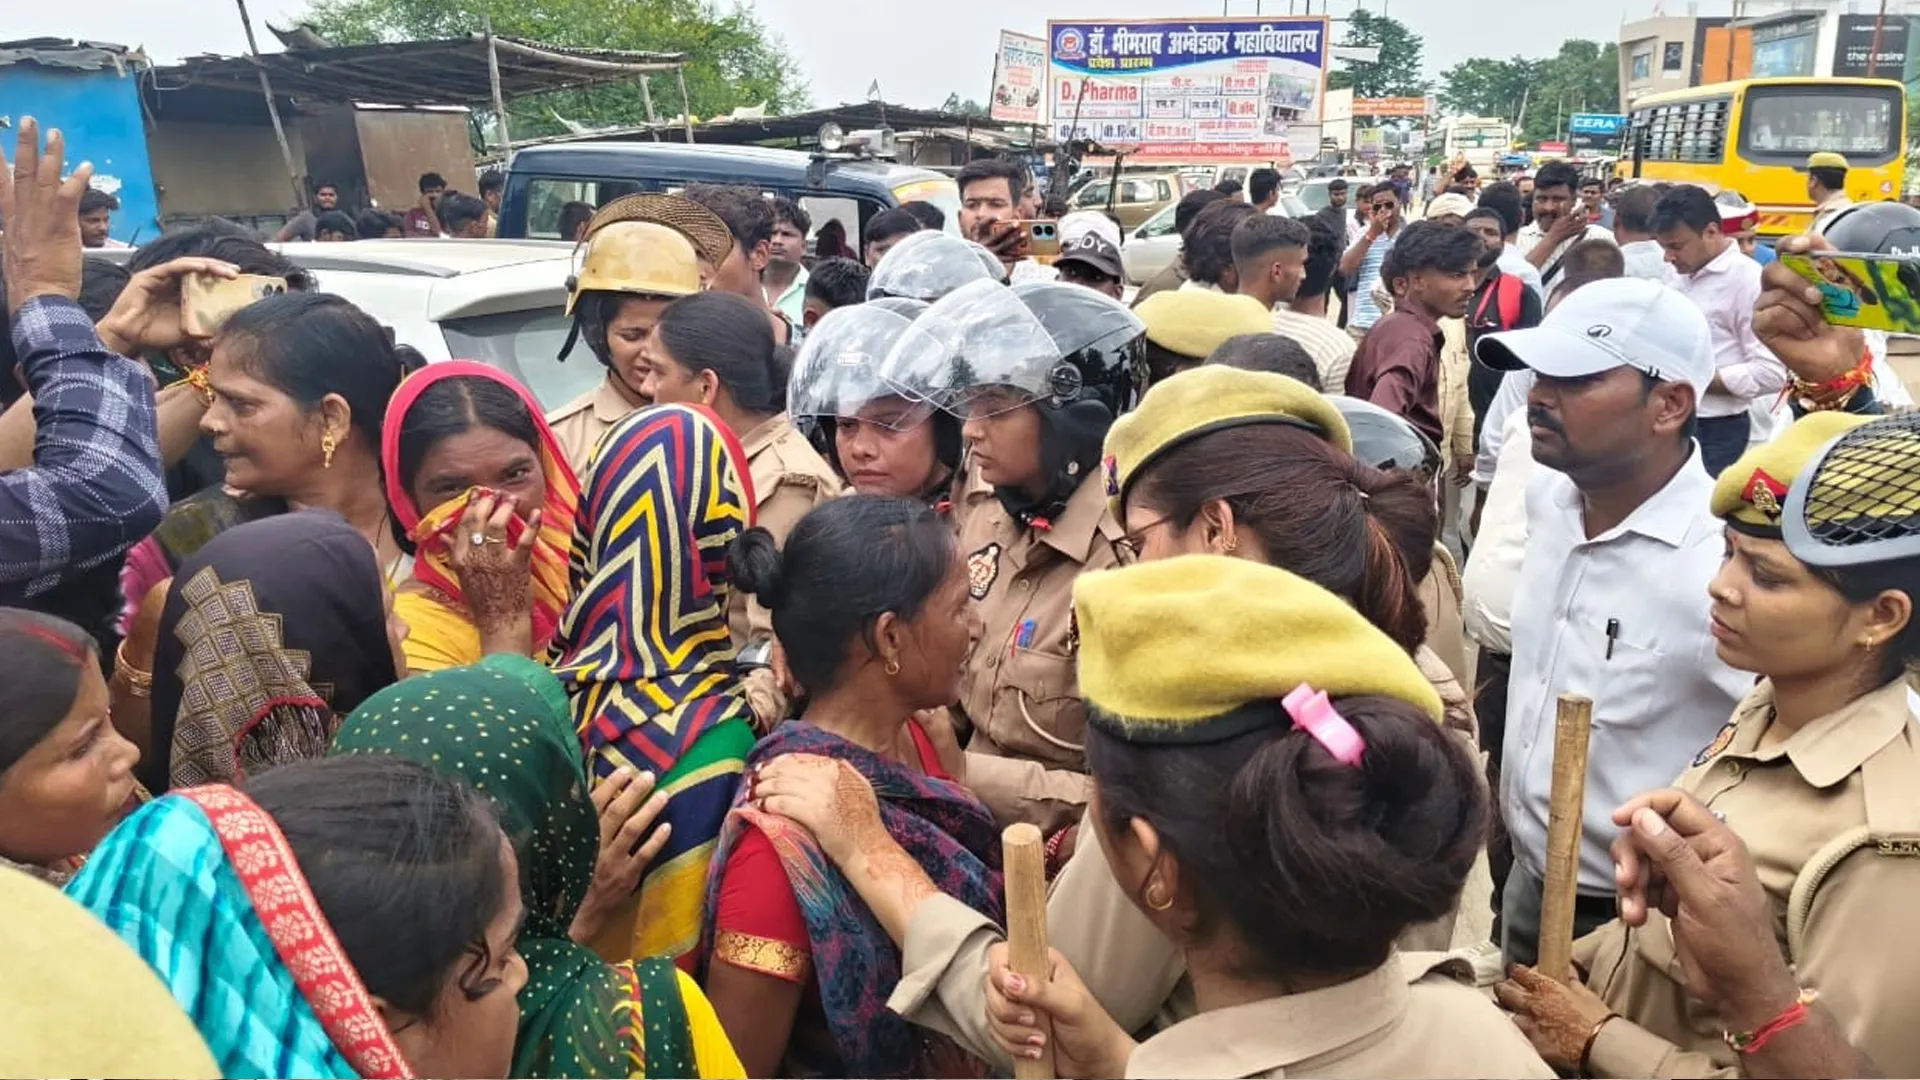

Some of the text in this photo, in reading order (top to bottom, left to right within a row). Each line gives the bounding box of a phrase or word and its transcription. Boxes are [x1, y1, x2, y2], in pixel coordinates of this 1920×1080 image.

[1088, 26, 1108, 56] डॉ.
[1112, 27, 1163, 55] भीमराव
[1233, 24, 1320, 54] महाविद्यालय
[1061, 81, 1076, 100] D.
[1082, 81, 1137, 100] Pharma
[1573, 118, 1616, 129] CERA
[1068, 235, 1107, 253] OY
